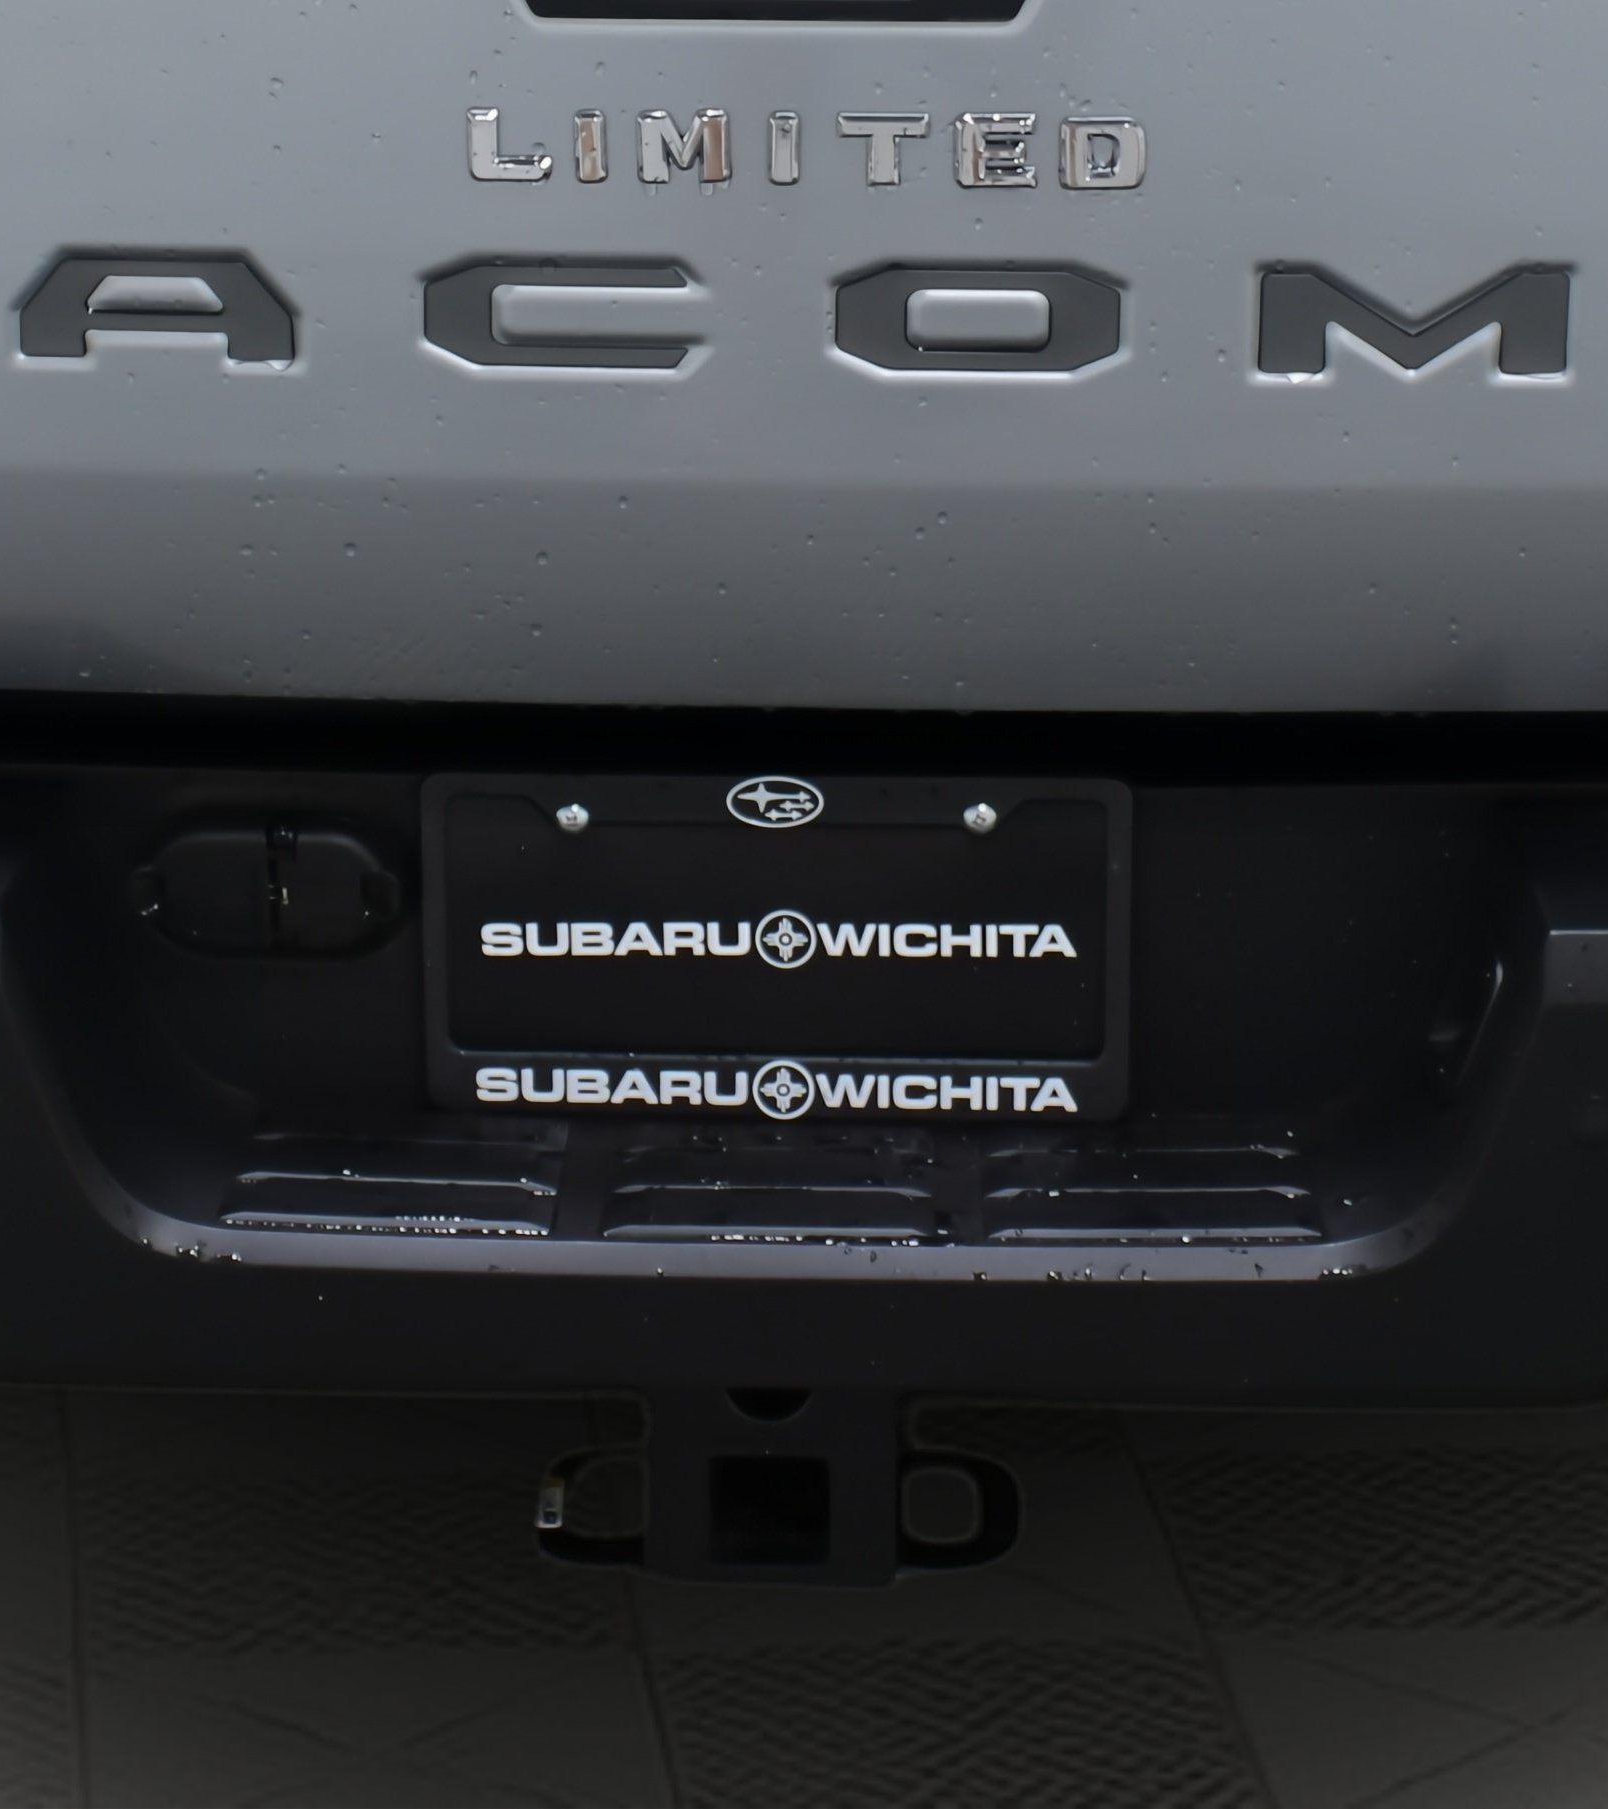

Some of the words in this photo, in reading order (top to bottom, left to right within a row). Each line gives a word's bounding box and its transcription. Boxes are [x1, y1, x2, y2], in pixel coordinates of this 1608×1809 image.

[466, 106, 1147, 190] LIMITED
[480, 922, 751, 957] SUBARU
[817, 923, 1077, 958] WICHITA
[475, 1067, 748, 1106] SUBARU
[815, 1074, 1079, 1112] WICHITA
